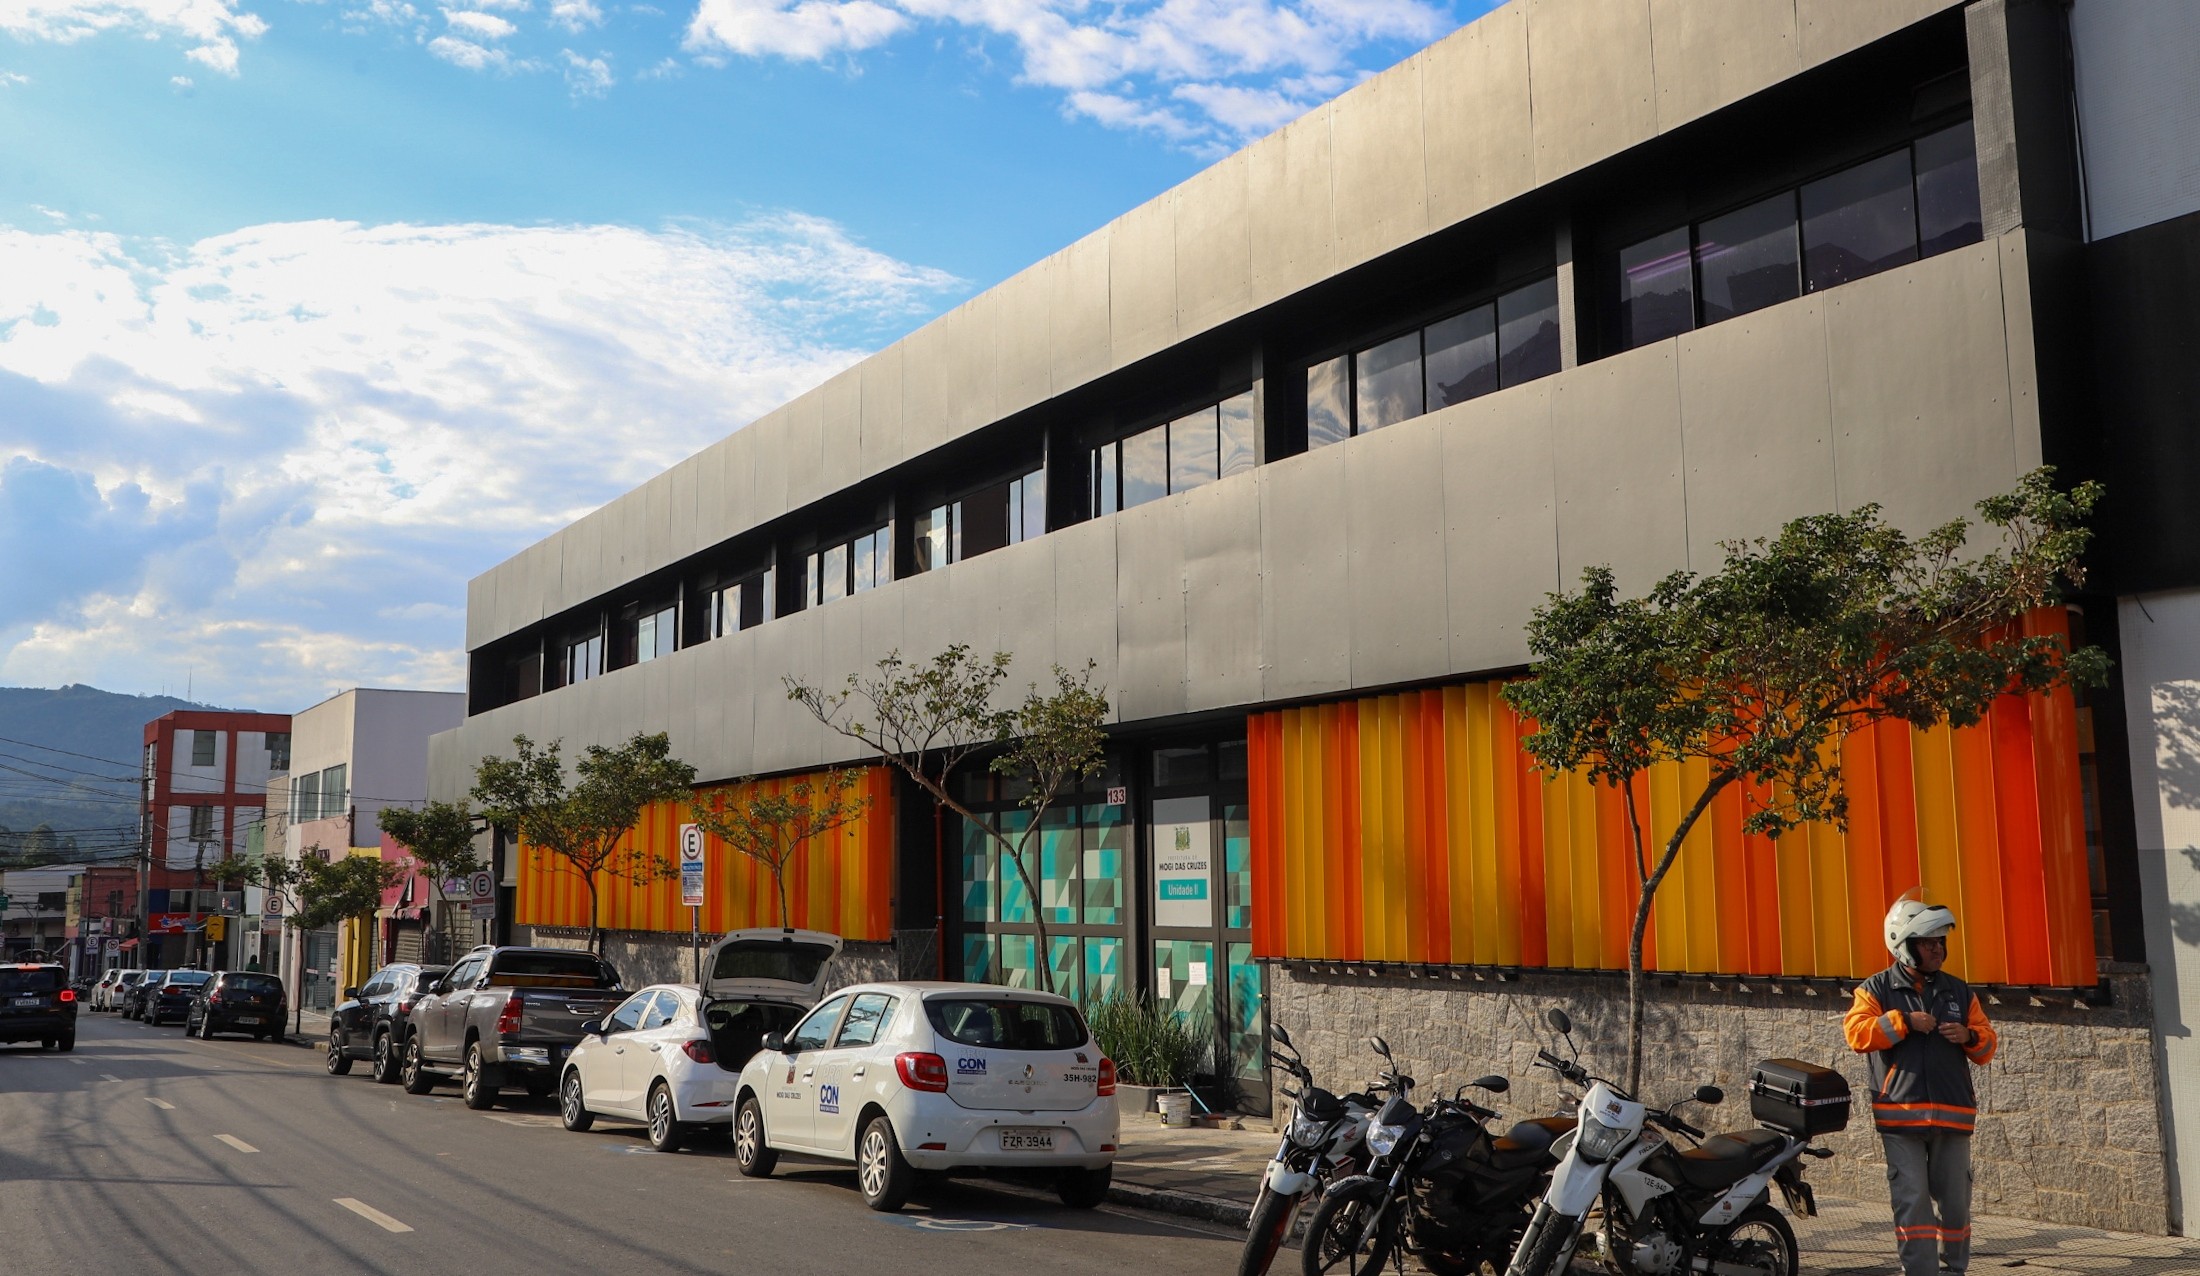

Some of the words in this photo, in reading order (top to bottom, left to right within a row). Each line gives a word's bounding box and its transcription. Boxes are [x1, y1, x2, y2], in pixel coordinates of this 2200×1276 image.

[1109, 789, 1125, 803] 133
[688, 834, 695, 852] E
[1159, 862, 1174, 870] MOGI
[1175, 862, 1185, 870] DAS
[1187, 861, 1207, 870] CRUZES
[480, 879, 486, 892] E
[1168, 884, 1193, 896] Unidade
[271, 900, 277, 910] E
[957, 1048, 986, 1058] PRO
[958, 1058, 986, 1070] CON
[820, 1084, 839, 1105] CON
